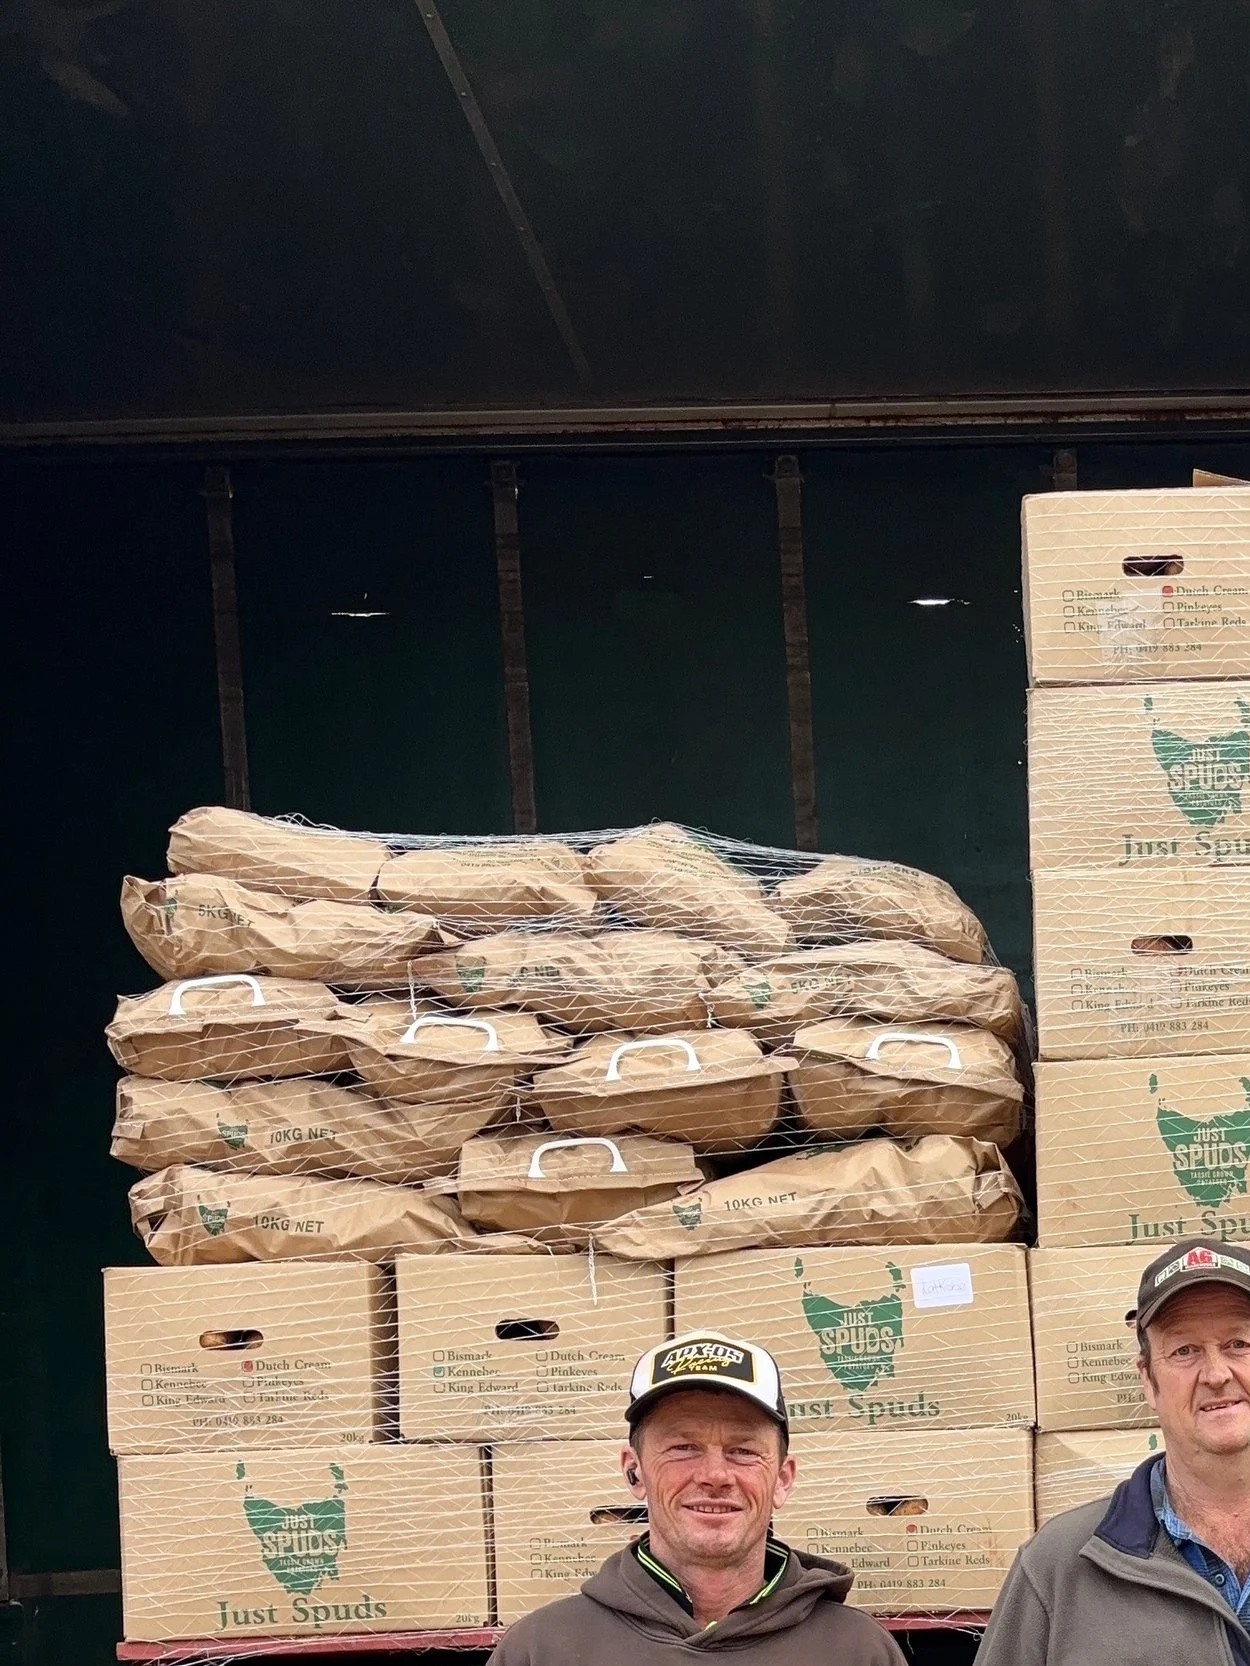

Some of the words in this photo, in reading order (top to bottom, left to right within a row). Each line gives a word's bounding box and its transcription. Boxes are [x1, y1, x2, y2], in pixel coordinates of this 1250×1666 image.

[1177, 601, 1223, 615] Pinkeyes
[1168, 762, 1243, 791] SPUDS
[1119, 833, 1180, 866] Just
[198, 904, 229, 920] 5KG
[1120, 1022, 1138, 1032] PH:
[1169, 1021, 1187, 1031] 883
[1191, 1021, 1209, 1030] 284
[270, 1128, 302, 1144] 10KG
[308, 1128, 339, 1141] NET
[1194, 1127, 1226, 1142] JUST
[1174, 1142, 1247, 1170] SPUDS
[724, 1197, 763, 1212] 10KG
[768, 1192, 797, 1204] NET
[253, 1215, 290, 1231] 10KG
[295, 1220, 324, 1233] NET
[1126, 1214, 1186, 1244] Just
[842, 1312, 874, 1326] JUST
[820, 1326, 894, 1354] SPUDS
[1080, 1340, 1124, 1352] Bismark
[446, 1350, 492, 1361] Bismark
[550, 1350, 585, 1361] Dutch
[1080, 1355, 1133, 1367] Kennebec
[256, 1360, 291, 1371] Dutch
[447, 1366, 502, 1377] Kennebec
[551, 1366, 599, 1379] Pinkeyes
[1081, 1372, 1105, 1385] King
[447, 1382, 472, 1394] King
[477, 1382, 519, 1392] Edward
[597, 1382, 623, 1392] Reds
[787, 1401, 834, 1420] ust
[848, 1392, 940, 1425] Spuds
[282, 1514, 314, 1530] JUST
[261, 1530, 338, 1558] SPUDS
[820, 1542, 873, 1553] Kennebec
[920, 1540, 967, 1553] Pinkeyes
[850, 1556, 891, 1567] Edward
[921, 1555, 962, 1566] Tarkine
[965, 1554, 991, 1565] Reds
[906, 1579, 924, 1588] 883
[928, 1579, 946, 1588] 284
[214, 1600, 278, 1632] Just
[292, 1595, 388, 1629] Spuds
